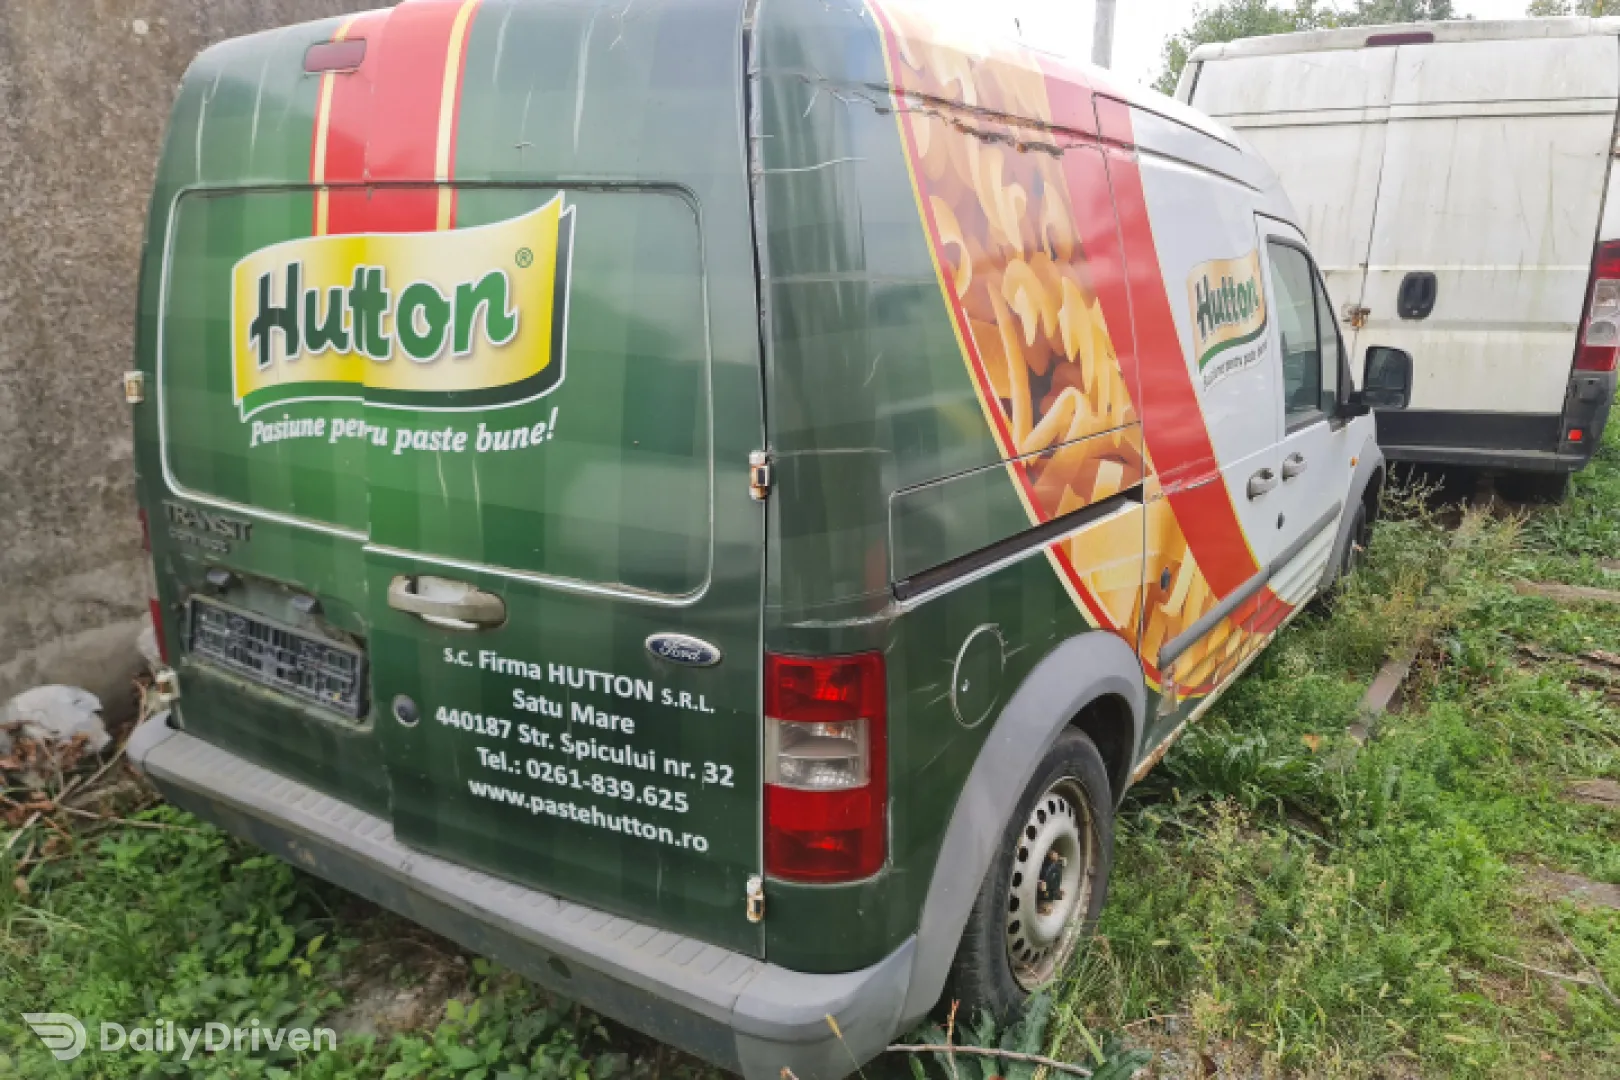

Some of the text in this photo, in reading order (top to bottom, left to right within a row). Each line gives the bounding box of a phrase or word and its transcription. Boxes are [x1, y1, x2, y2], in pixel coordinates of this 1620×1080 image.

[249, 260, 518, 369] Hutton
[1194, 274, 1260, 345] Hutton
[250, 413, 326, 448] Pasiune
[392, 425, 468, 455] paste
[476, 406, 559, 452] bune!
[478, 649, 541, 680] Firma
[548, 662, 654, 702] HUTTON
[512, 688, 636, 734] Satu Mare
[435, 706, 735, 788] 440187 Str. Spicului nr. 32
[475, 746, 689, 813] Tel.: 0261-839.625
[467, 780, 709, 853] www.pastehutton.ro
